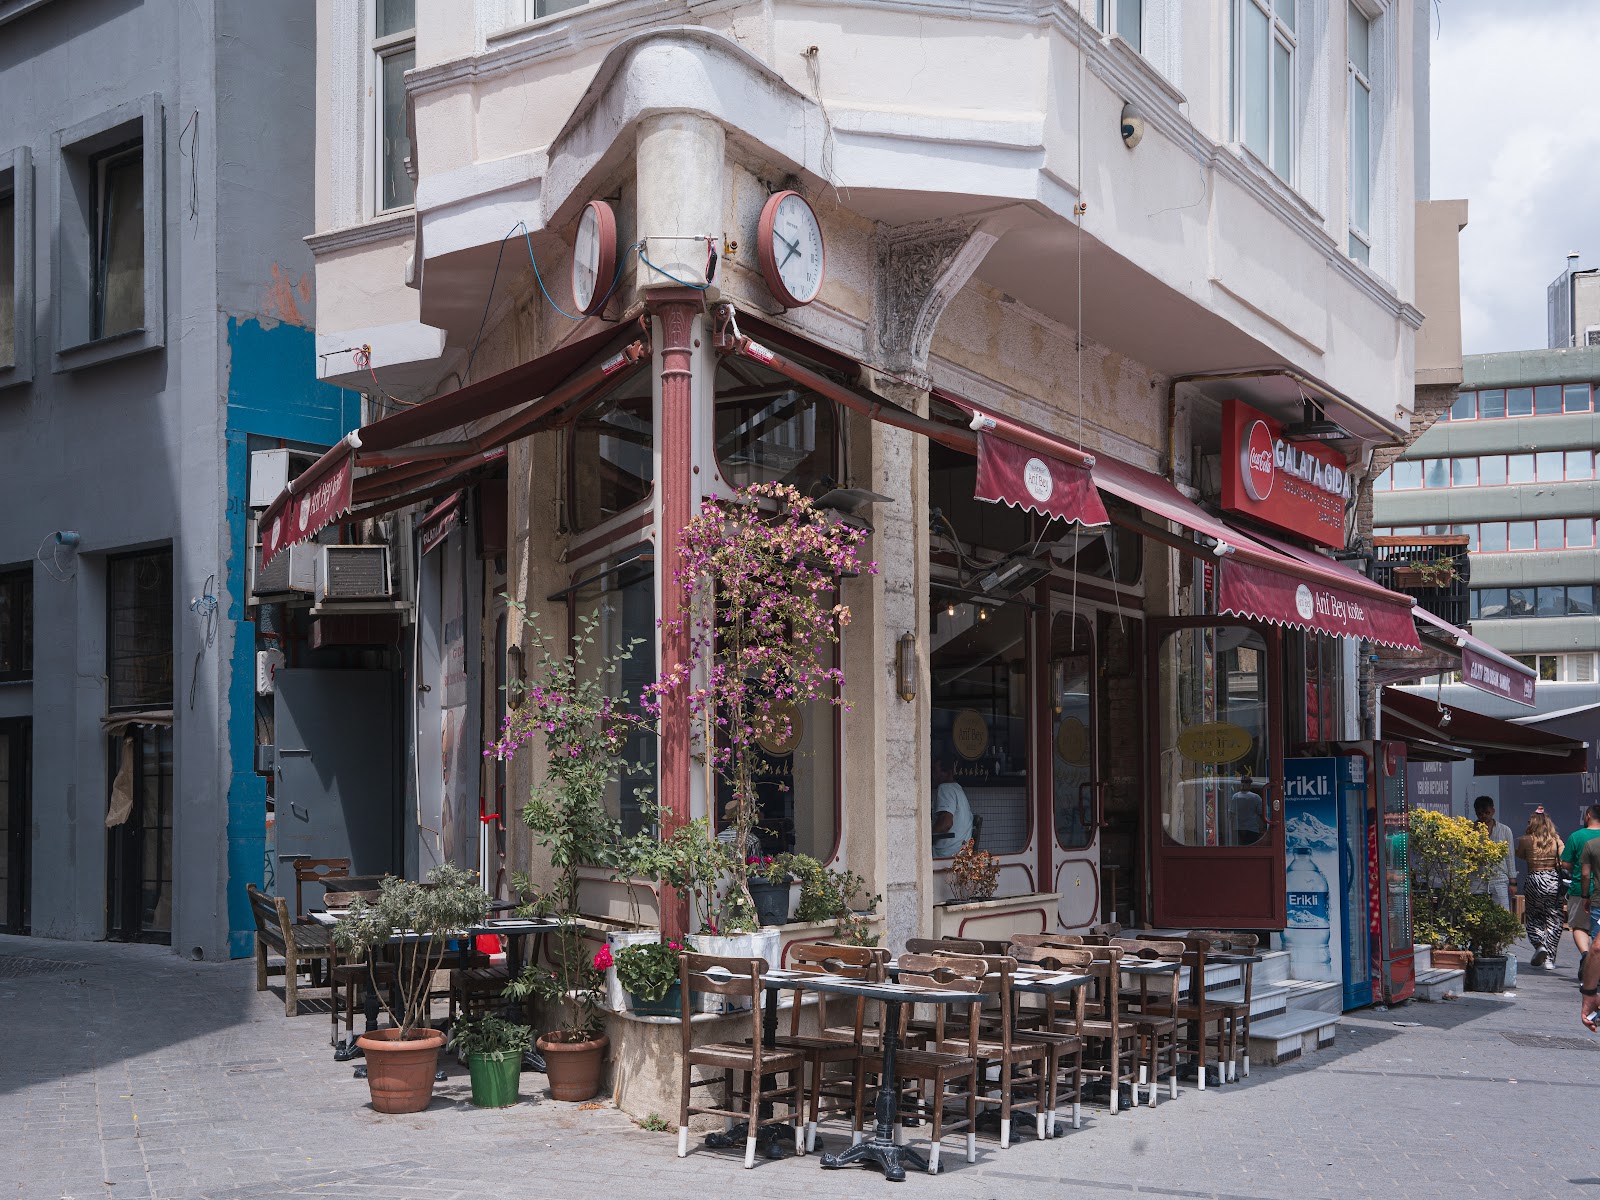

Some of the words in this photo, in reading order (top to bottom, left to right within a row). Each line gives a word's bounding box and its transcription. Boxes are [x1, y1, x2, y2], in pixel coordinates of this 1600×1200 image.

[1250, 447, 1272, 473] Coca-Cola
[1276, 439, 1322, 487] GALATA
[1325, 463, 1351, 499] GIDA
[1315, 592, 1331, 616] Arif
[1331, 596, 1347, 626] Bey
[953, 760, 989, 782] Karaköy
[1289, 894, 1318, 906] Erikli
